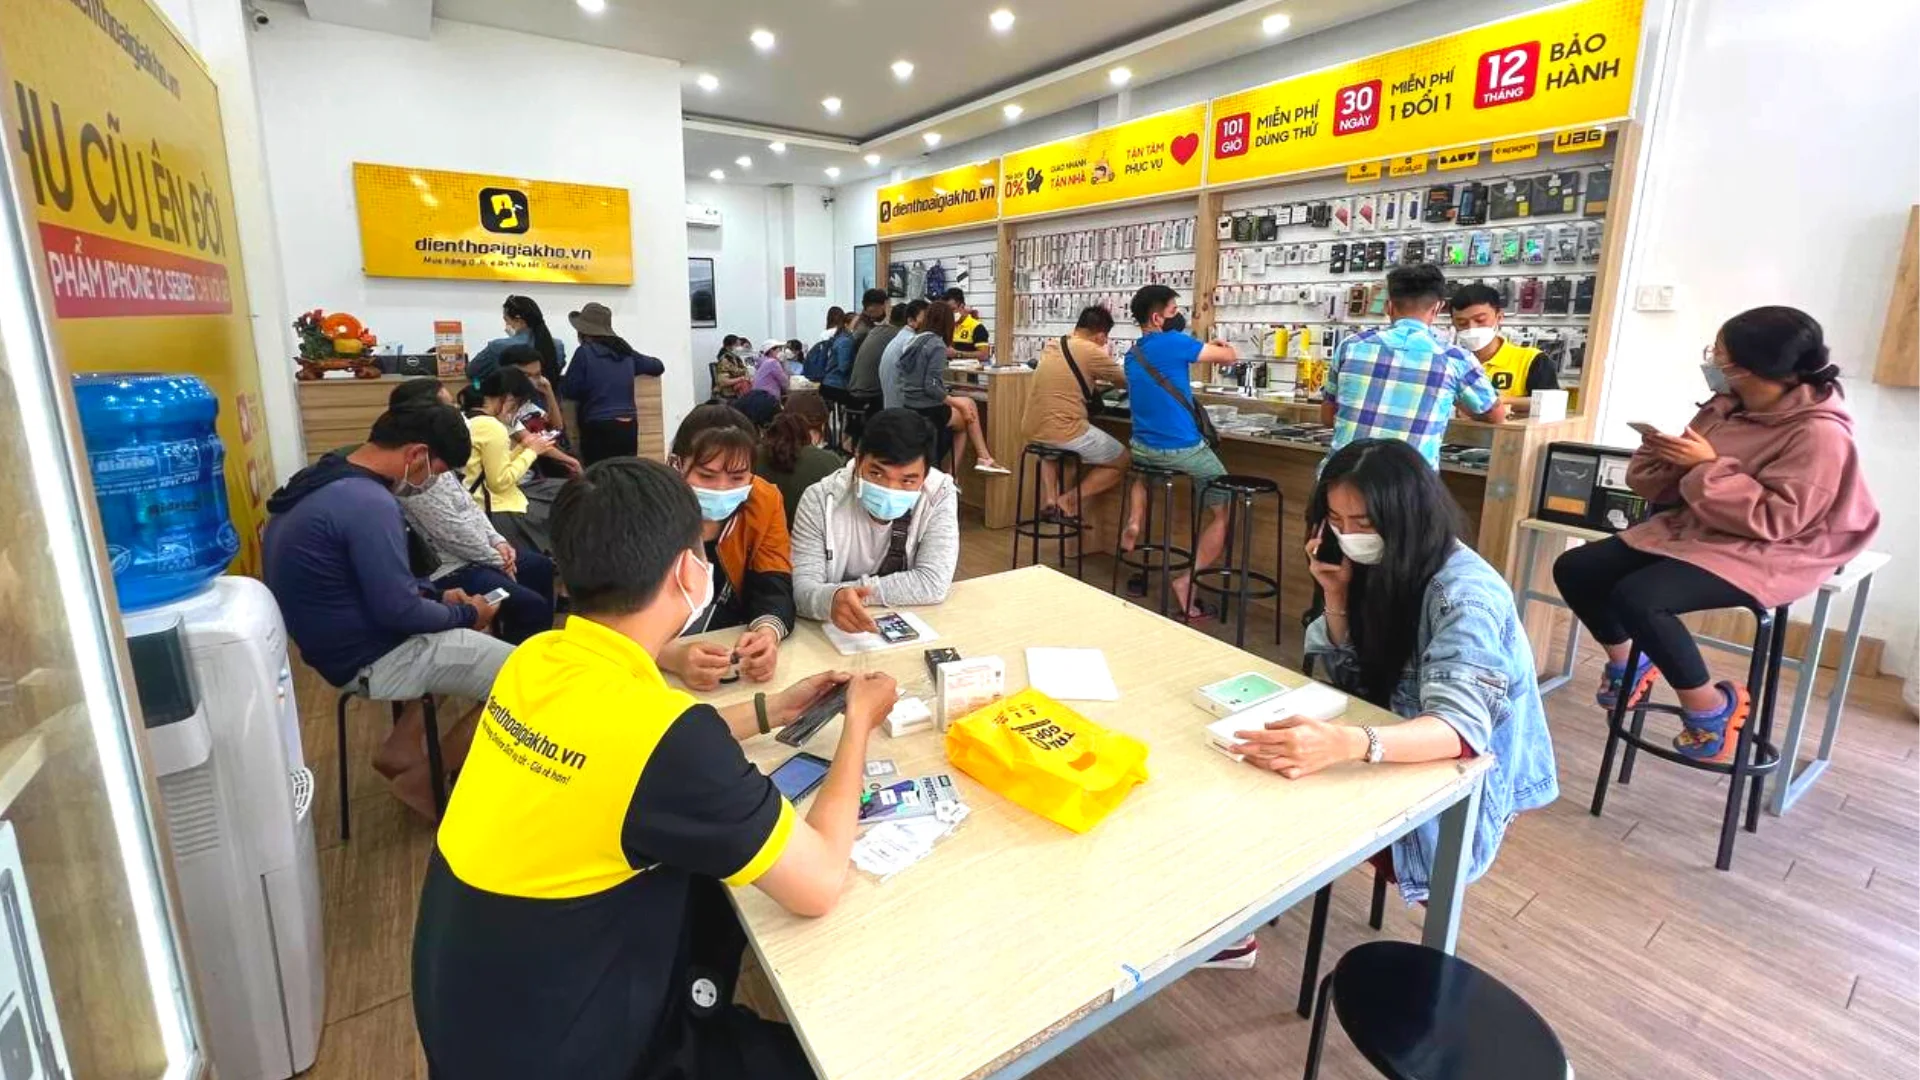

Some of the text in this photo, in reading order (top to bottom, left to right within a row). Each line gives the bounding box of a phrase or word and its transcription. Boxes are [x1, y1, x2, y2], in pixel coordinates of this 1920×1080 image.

[1549, 32, 1607, 62] BẢO
[1391, 65, 1456, 96] MIỄN PHÍ
[1487, 49, 1528, 89] 12
[1546, 58, 1621, 91] HÀNH
[1341, 86, 1373, 115] 30
[1390, 89, 1451, 121] 1 ĐỔI 1
[1484, 86, 1524, 103] THÁNG
[1222, 118, 1243, 137] 101
[1256, 98, 1320, 131] MIỄN PHÍ
[1339, 113, 1371, 131] NGÀY
[1221, 137, 1242, 153] GIỜ
[1255, 121, 1320, 147] DÙNG THỬ
[80, 111, 138, 232] CŨ
[137, 138, 192, 247] LÊN
[1004, 179, 1024, 198] 0%
[892, 185, 995, 217] dienthoaigiakho.vn
